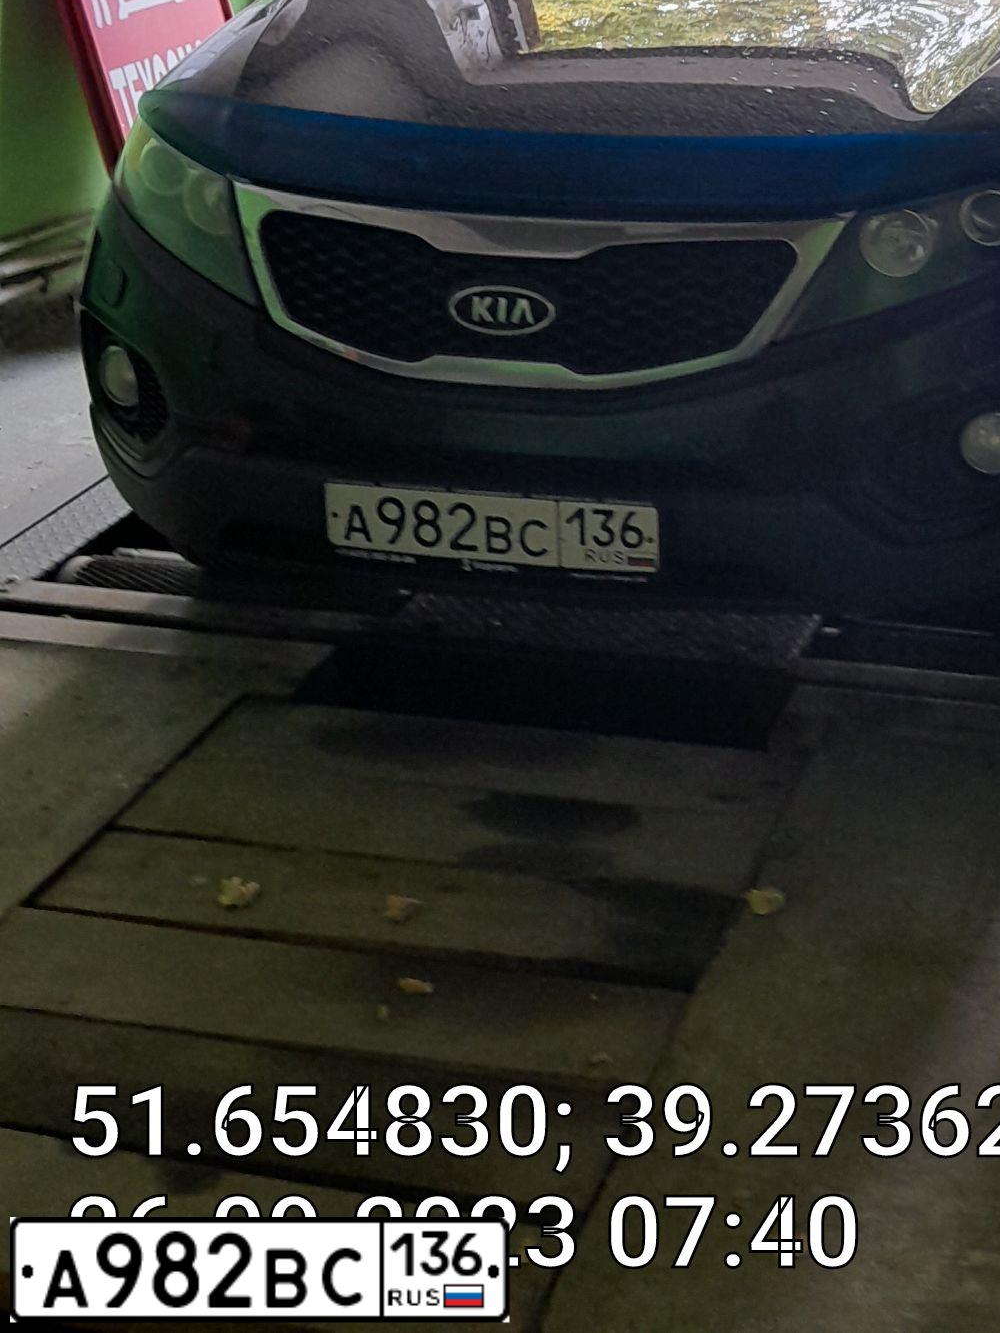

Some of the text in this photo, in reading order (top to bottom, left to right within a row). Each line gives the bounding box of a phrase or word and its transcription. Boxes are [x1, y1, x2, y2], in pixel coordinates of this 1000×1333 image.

[471, 296, 535, 324] KIA
[344, 496, 645, 557] А982ВС 136
[584, 548, 625, 565] RUS
